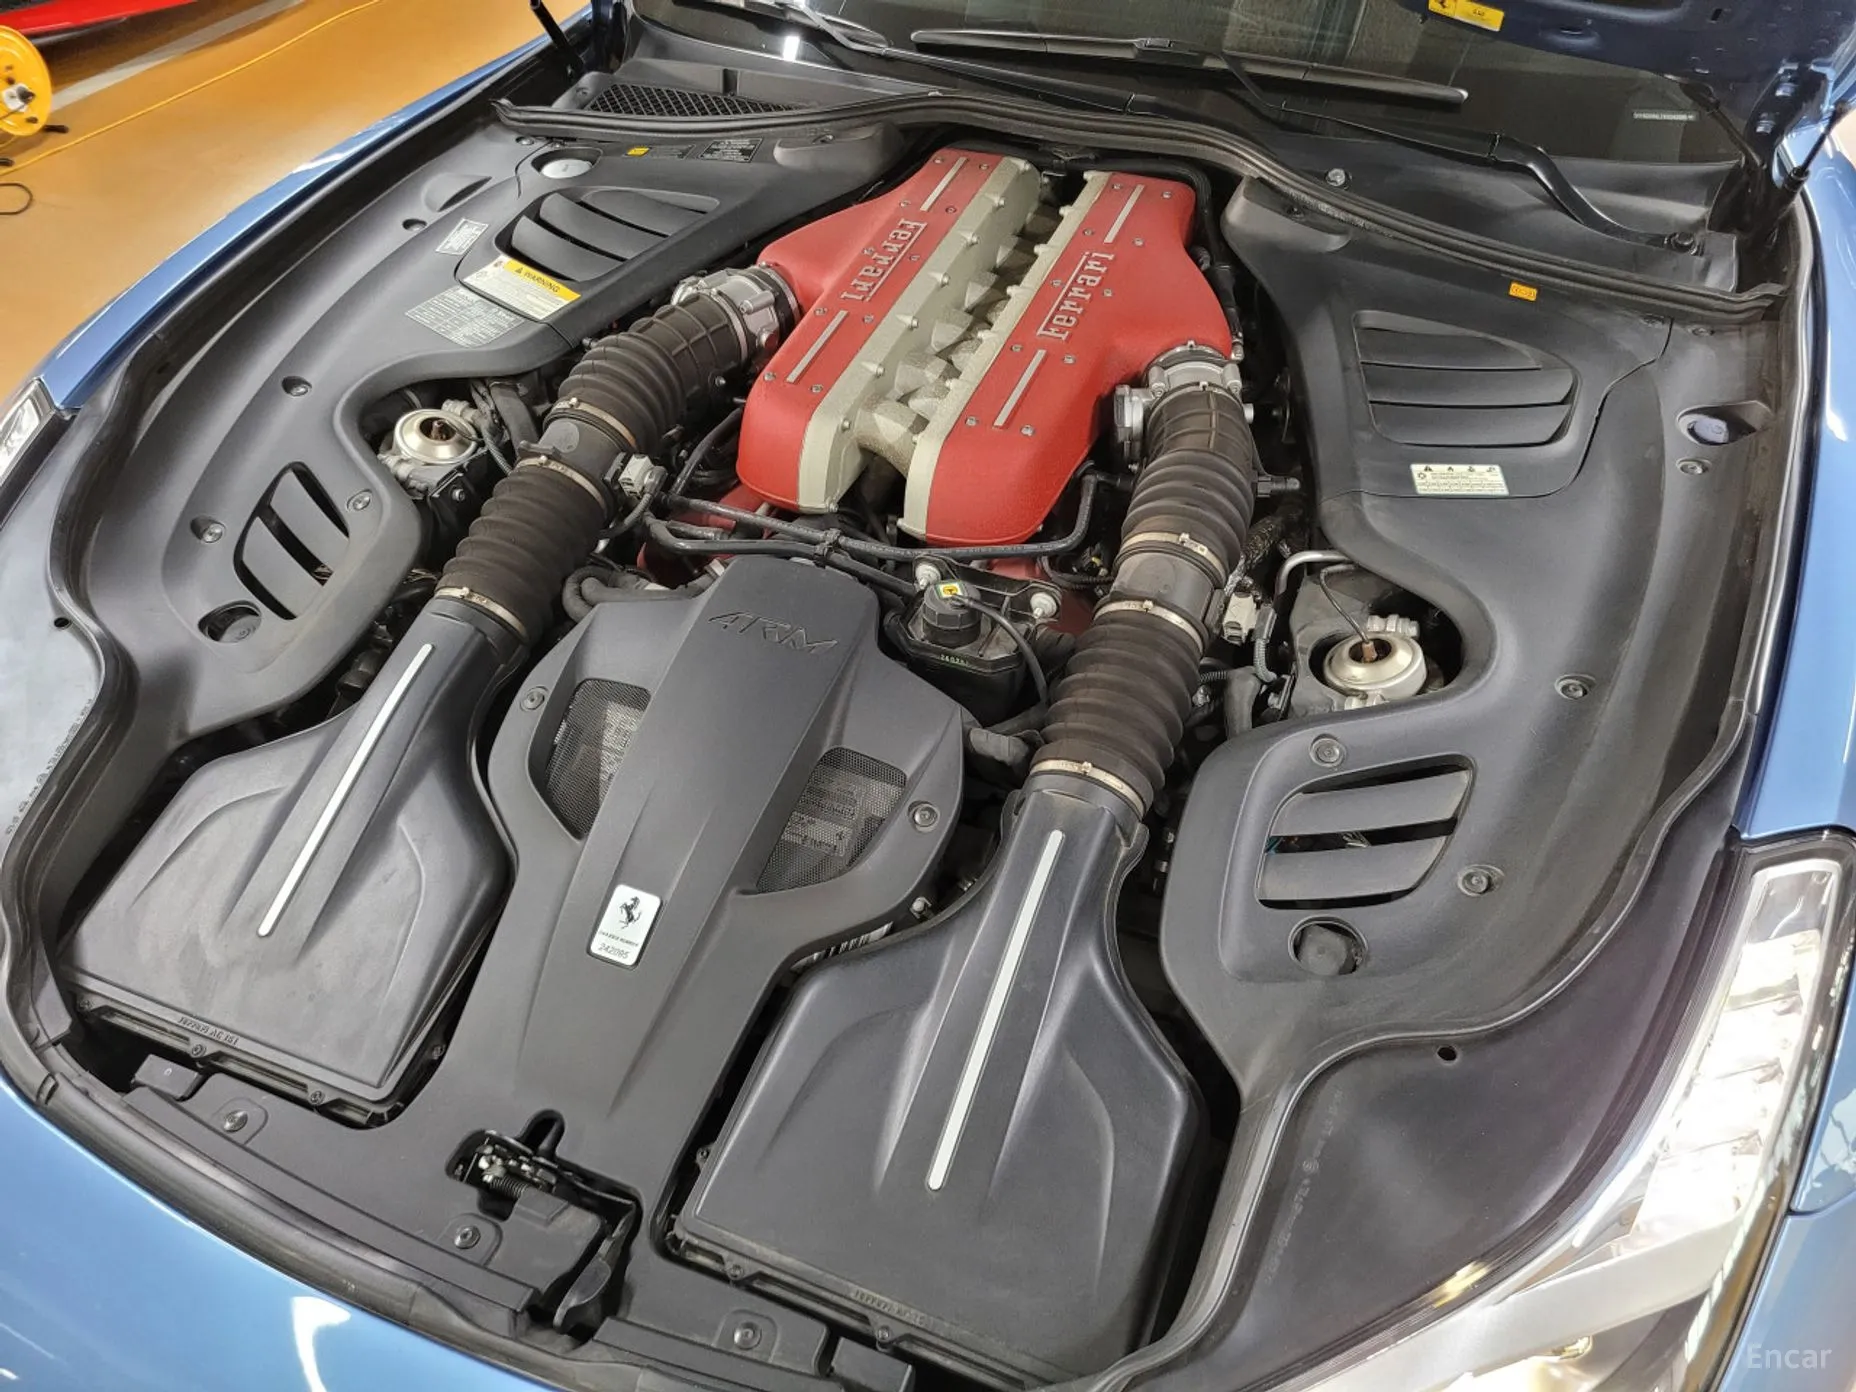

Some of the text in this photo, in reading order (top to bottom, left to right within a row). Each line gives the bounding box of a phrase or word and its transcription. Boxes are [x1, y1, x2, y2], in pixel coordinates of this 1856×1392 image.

[523, 270, 561, 293] WARNING
[841, 219, 927, 302] Ferrari
[1037, 252, 1115, 341] Ferrari
